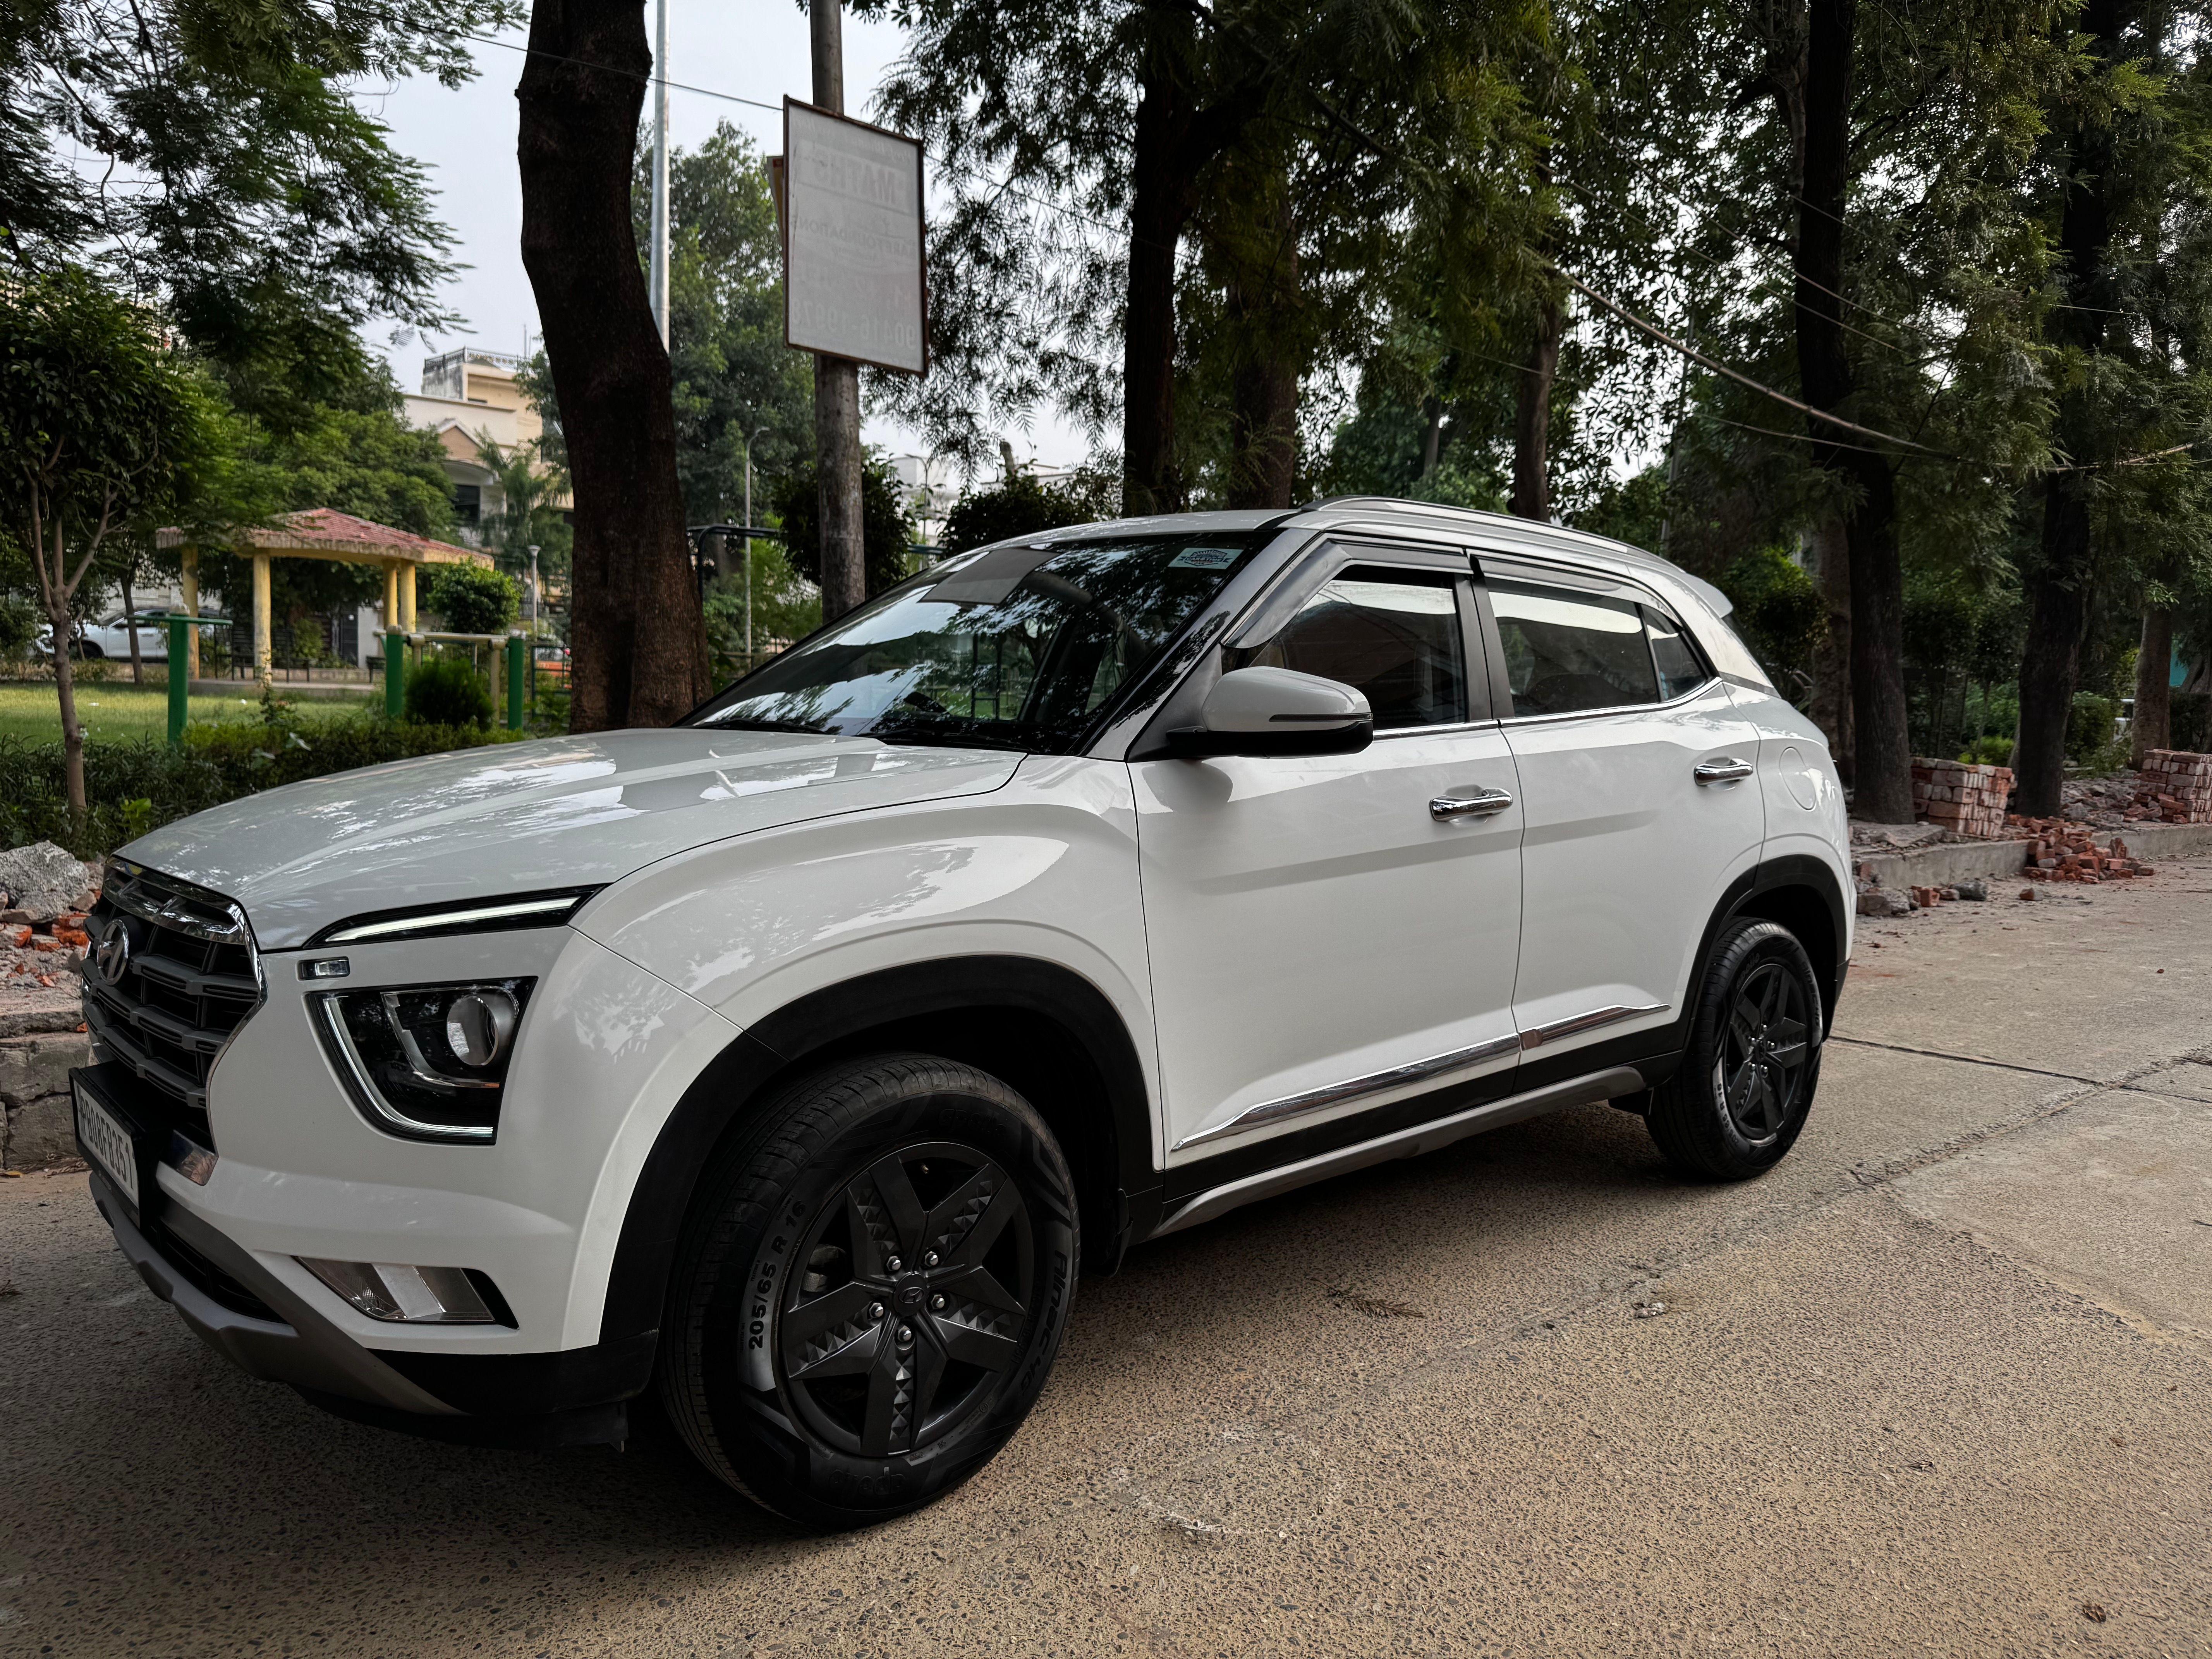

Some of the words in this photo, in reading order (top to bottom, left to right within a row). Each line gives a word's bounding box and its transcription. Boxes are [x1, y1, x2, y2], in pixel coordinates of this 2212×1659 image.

[80, 1096, 135, 1190] PB08FB351
[748, 1262, 776, 1350] 205/65
[771, 1235, 788, 1255] R
[785, 1200, 806, 1228] 16
